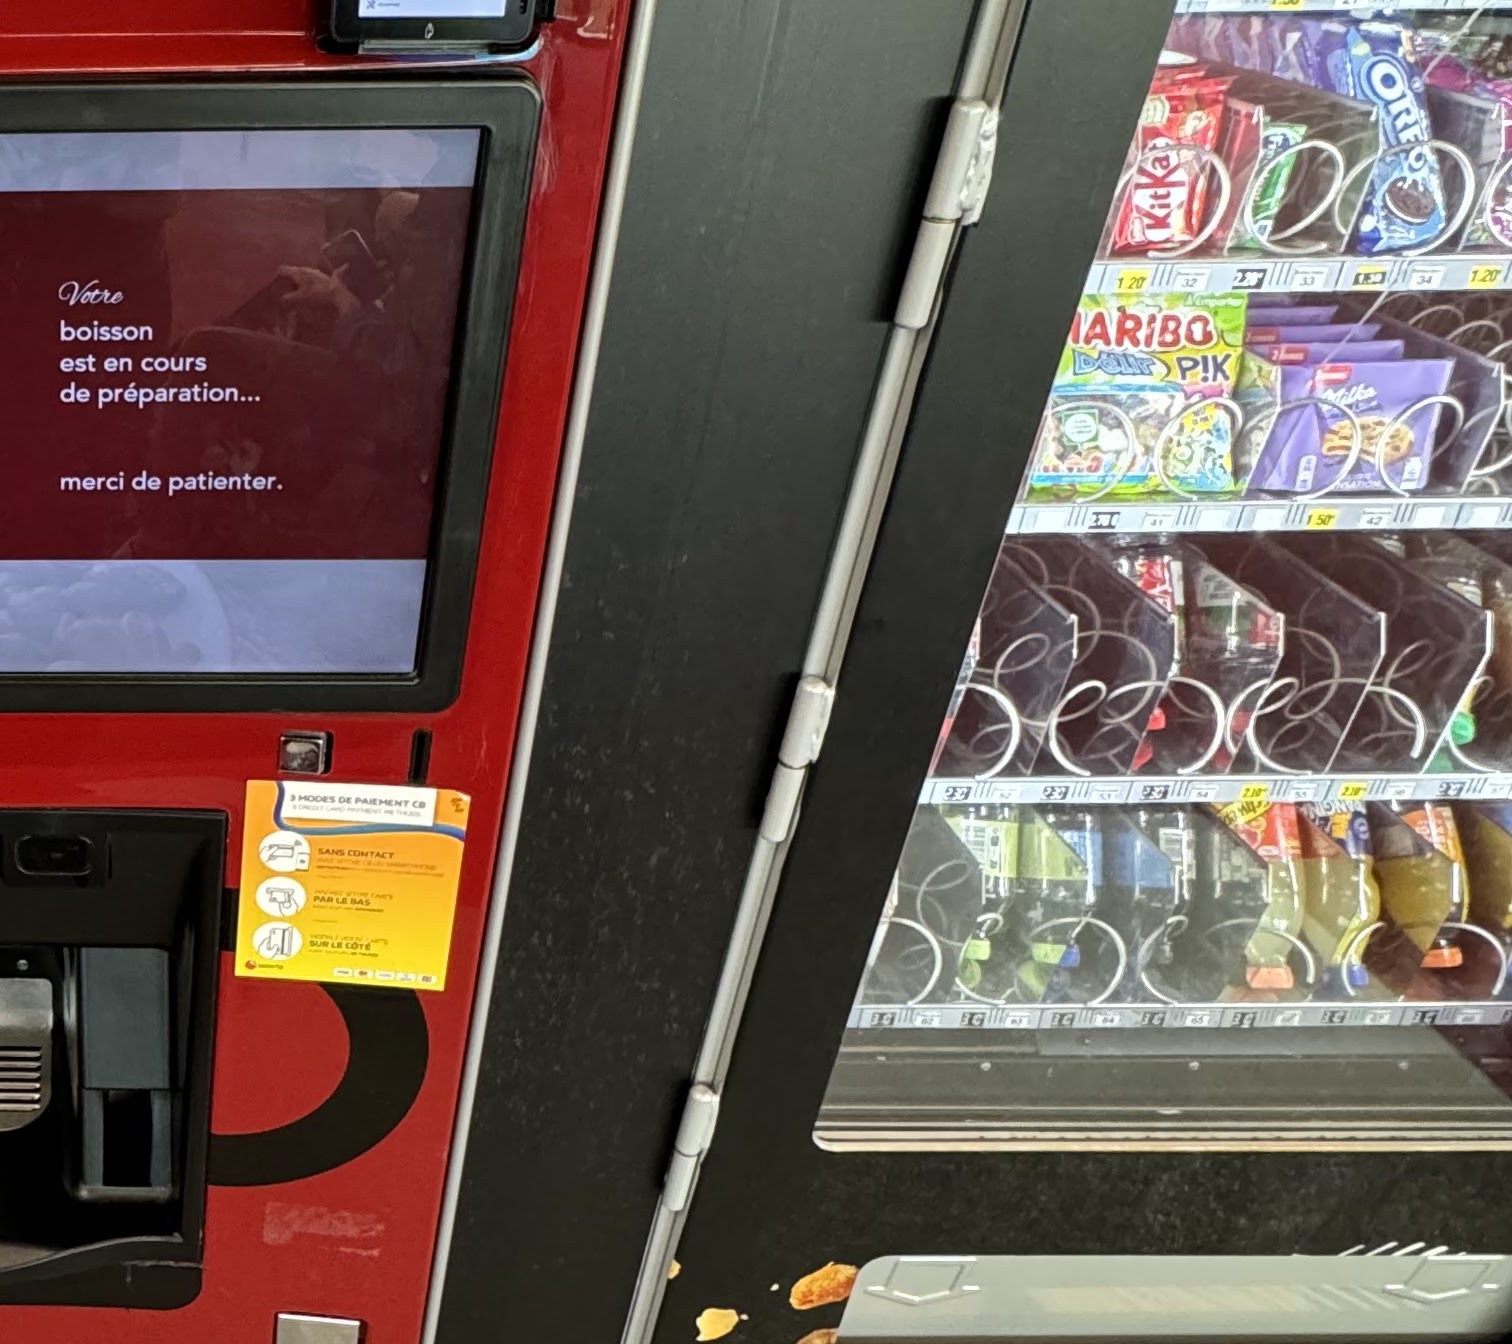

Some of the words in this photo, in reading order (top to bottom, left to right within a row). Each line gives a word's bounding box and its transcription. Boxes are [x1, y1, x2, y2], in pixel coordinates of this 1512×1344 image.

[1370, 62, 1430, 170] OREO
[1134, 140, 1186, 232] KitKat
[58, 280, 124, 306] Votre
[59, 320, 153, 341] boisson
[59, 354, 97, 372] est
[103, 357, 133, 372] en
[140, 356, 207, 372] cours
[59, 382, 91, 403] de
[98, 382, 261, 409] préparation...
[59, 471, 125, 491] merci
[131, 470, 162, 491] de
[168, 471, 284, 496] patienter.
[298, 794, 336, 803] MODES
[338, 796, 352, 805] DE
[355, 797, 409, 807] PAIEMENT
[317, 847, 345, 857] SANS
[347, 849, 395, 860] CONTACT
[313, 895, 334, 904] PAR
[336, 897, 348, 905] LE
[350, 898, 371, 907] BAS
[309, 939, 330, 948] SUR
[331, 941, 343, 949] LE
[345, 941, 371, 951] CÔTÉ
